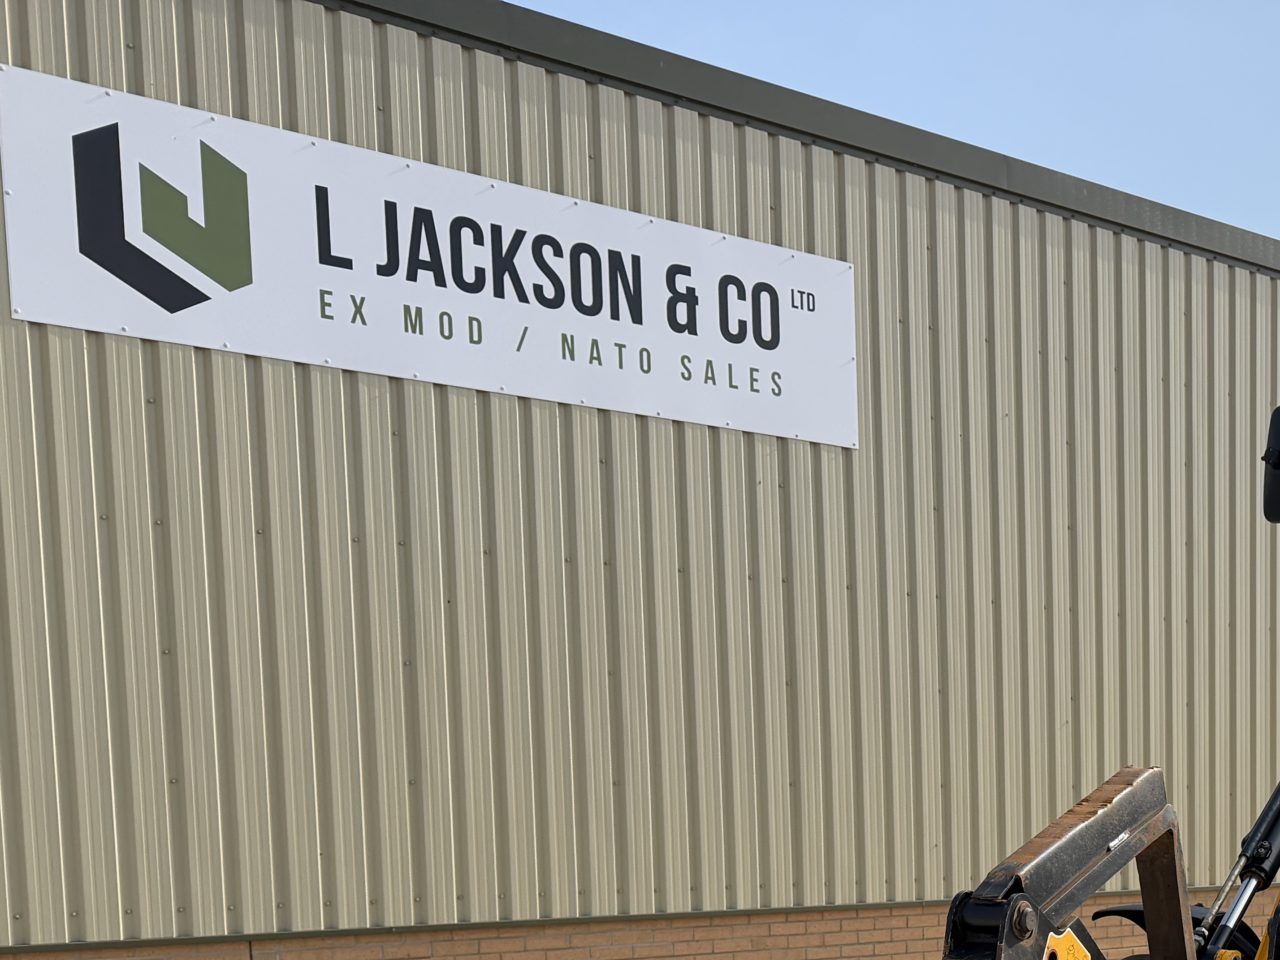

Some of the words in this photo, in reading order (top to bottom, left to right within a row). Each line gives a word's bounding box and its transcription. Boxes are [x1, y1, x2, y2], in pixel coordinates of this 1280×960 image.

[315, 184, 353, 270] L
[376, 199, 643, 326] JACKSON
[665, 263, 699, 336] &
[718, 274, 780, 350] CO
[790, 288, 816, 312] LTD
[319, 289, 367, 326] EX
[403, 304, 482, 345] MOD
[516, 326, 528, 352] /
[561, 333, 652, 374] NATO
[680, 354, 782, 397] SALES
